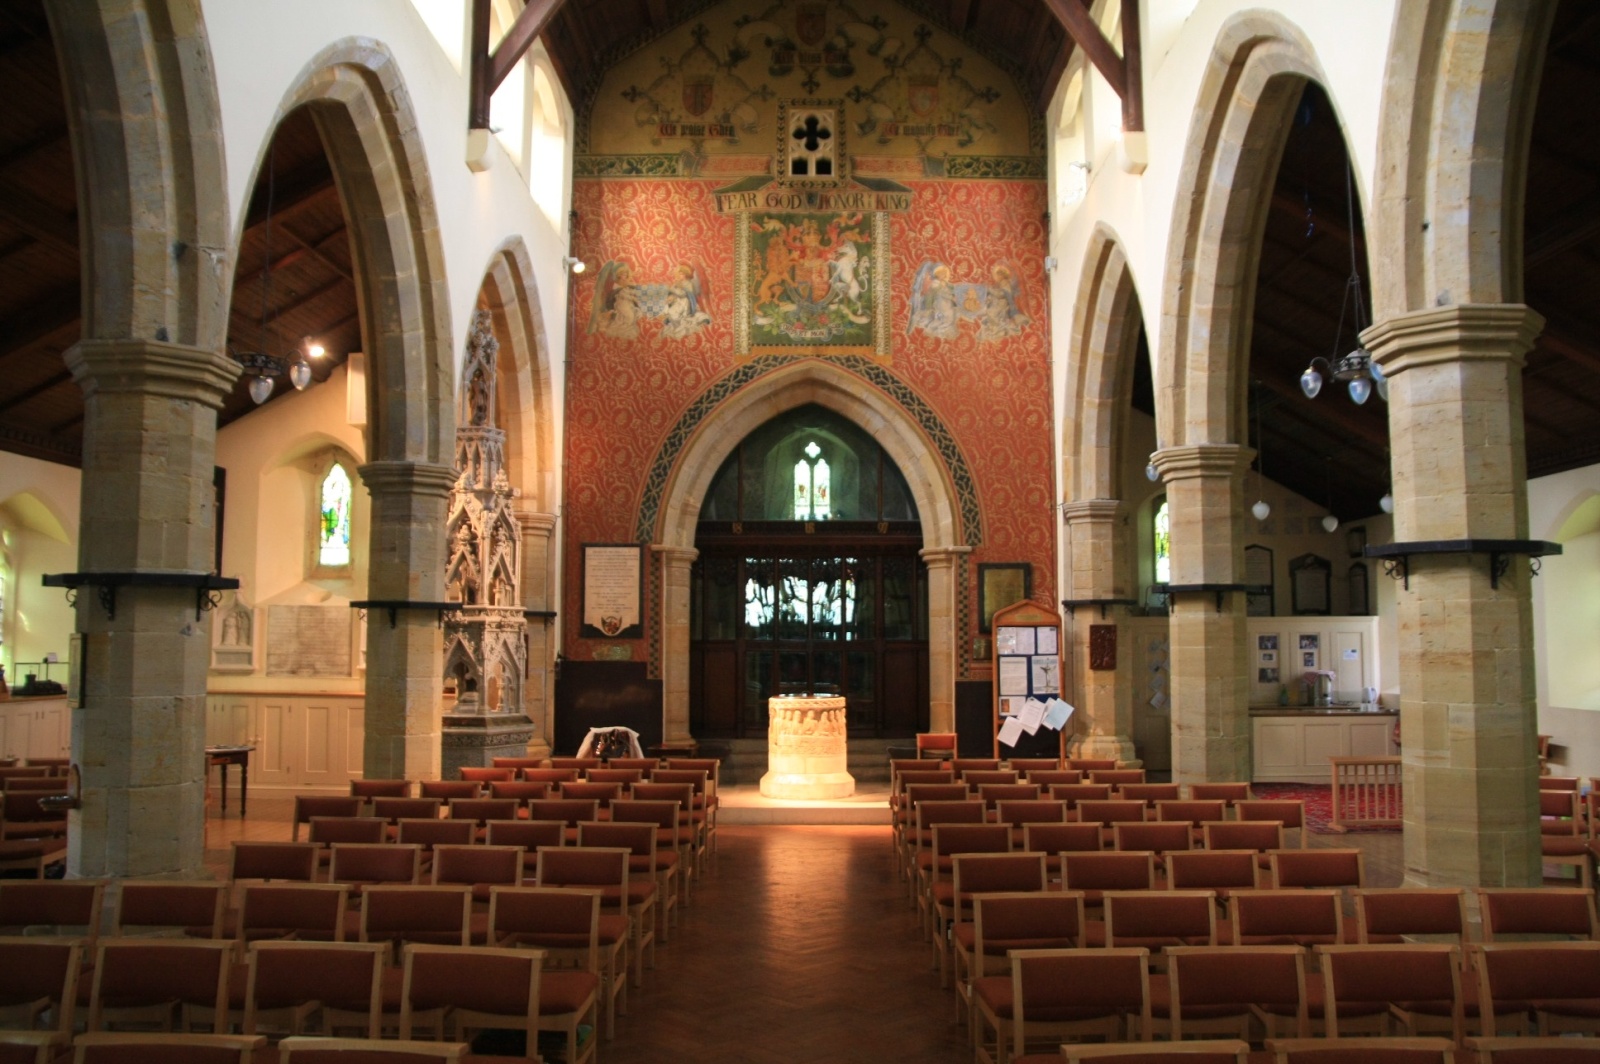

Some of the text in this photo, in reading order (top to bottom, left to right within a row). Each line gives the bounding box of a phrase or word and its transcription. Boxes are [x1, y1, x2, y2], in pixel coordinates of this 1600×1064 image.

[716, 192, 758, 212] FEAR
[766, 192, 802, 210] GOD
[818, 192, 865, 210] HONOR
[876, 192, 910, 210] KING
